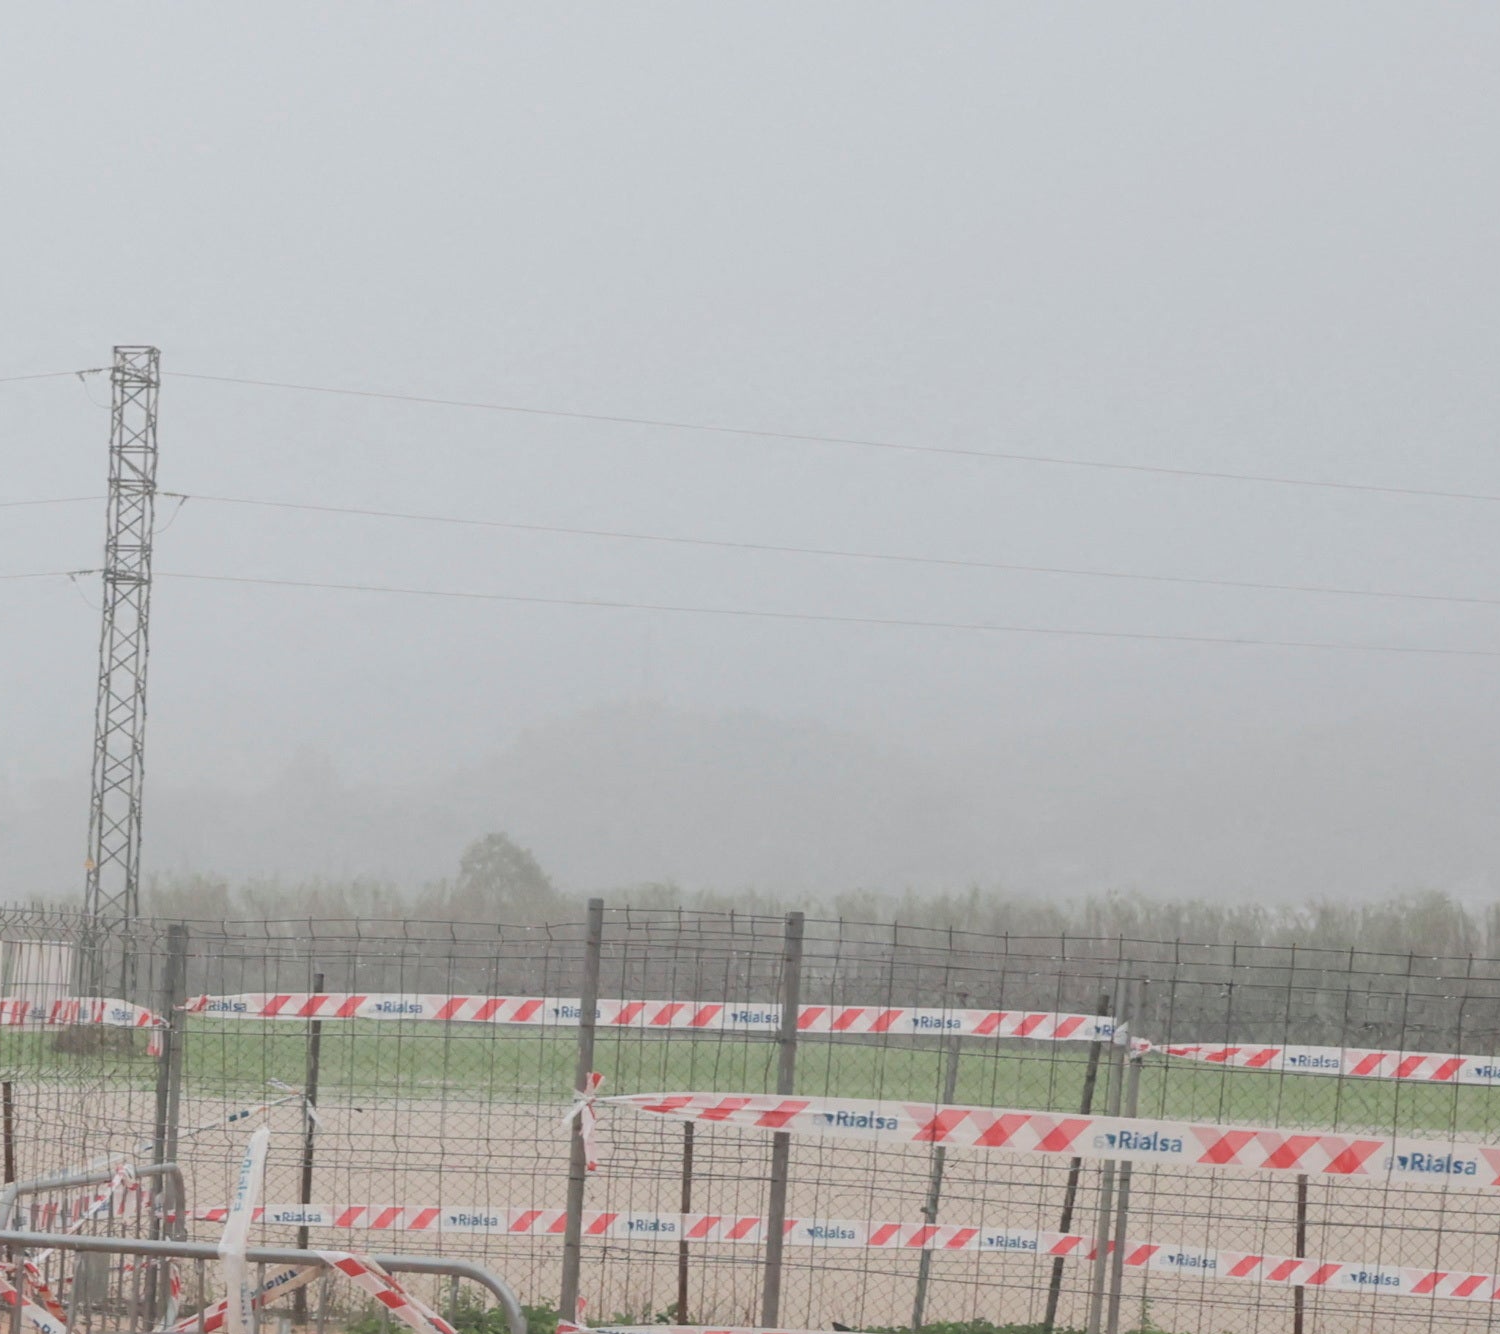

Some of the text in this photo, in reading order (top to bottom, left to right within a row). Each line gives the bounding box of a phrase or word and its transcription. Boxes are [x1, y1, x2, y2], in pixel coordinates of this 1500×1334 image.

[383, 1000, 423, 1014] Rialsa
[738, 1010, 780, 1024] Rialsa
[920, 1015, 962, 1030] Rialsa
[1297, 1053, 1340, 1069] Rialsa
[836, 1109, 898, 1131] Rialsa
[1118, 1130, 1183, 1154] Rialsa
[1410, 1152, 1478, 1176] Rialsa
[282, 1211, 322, 1224] Rialsa
[458, 1211, 499, 1227] Rialsa
[635, 1218, 676, 1232] Rialsa
[814, 1226, 855, 1240] Rialsa
[995, 1234, 1038, 1251] Rialsa
[1175, 1253, 1217, 1270] Rialsa
[1358, 1270, 1400, 1287] Rialsa
